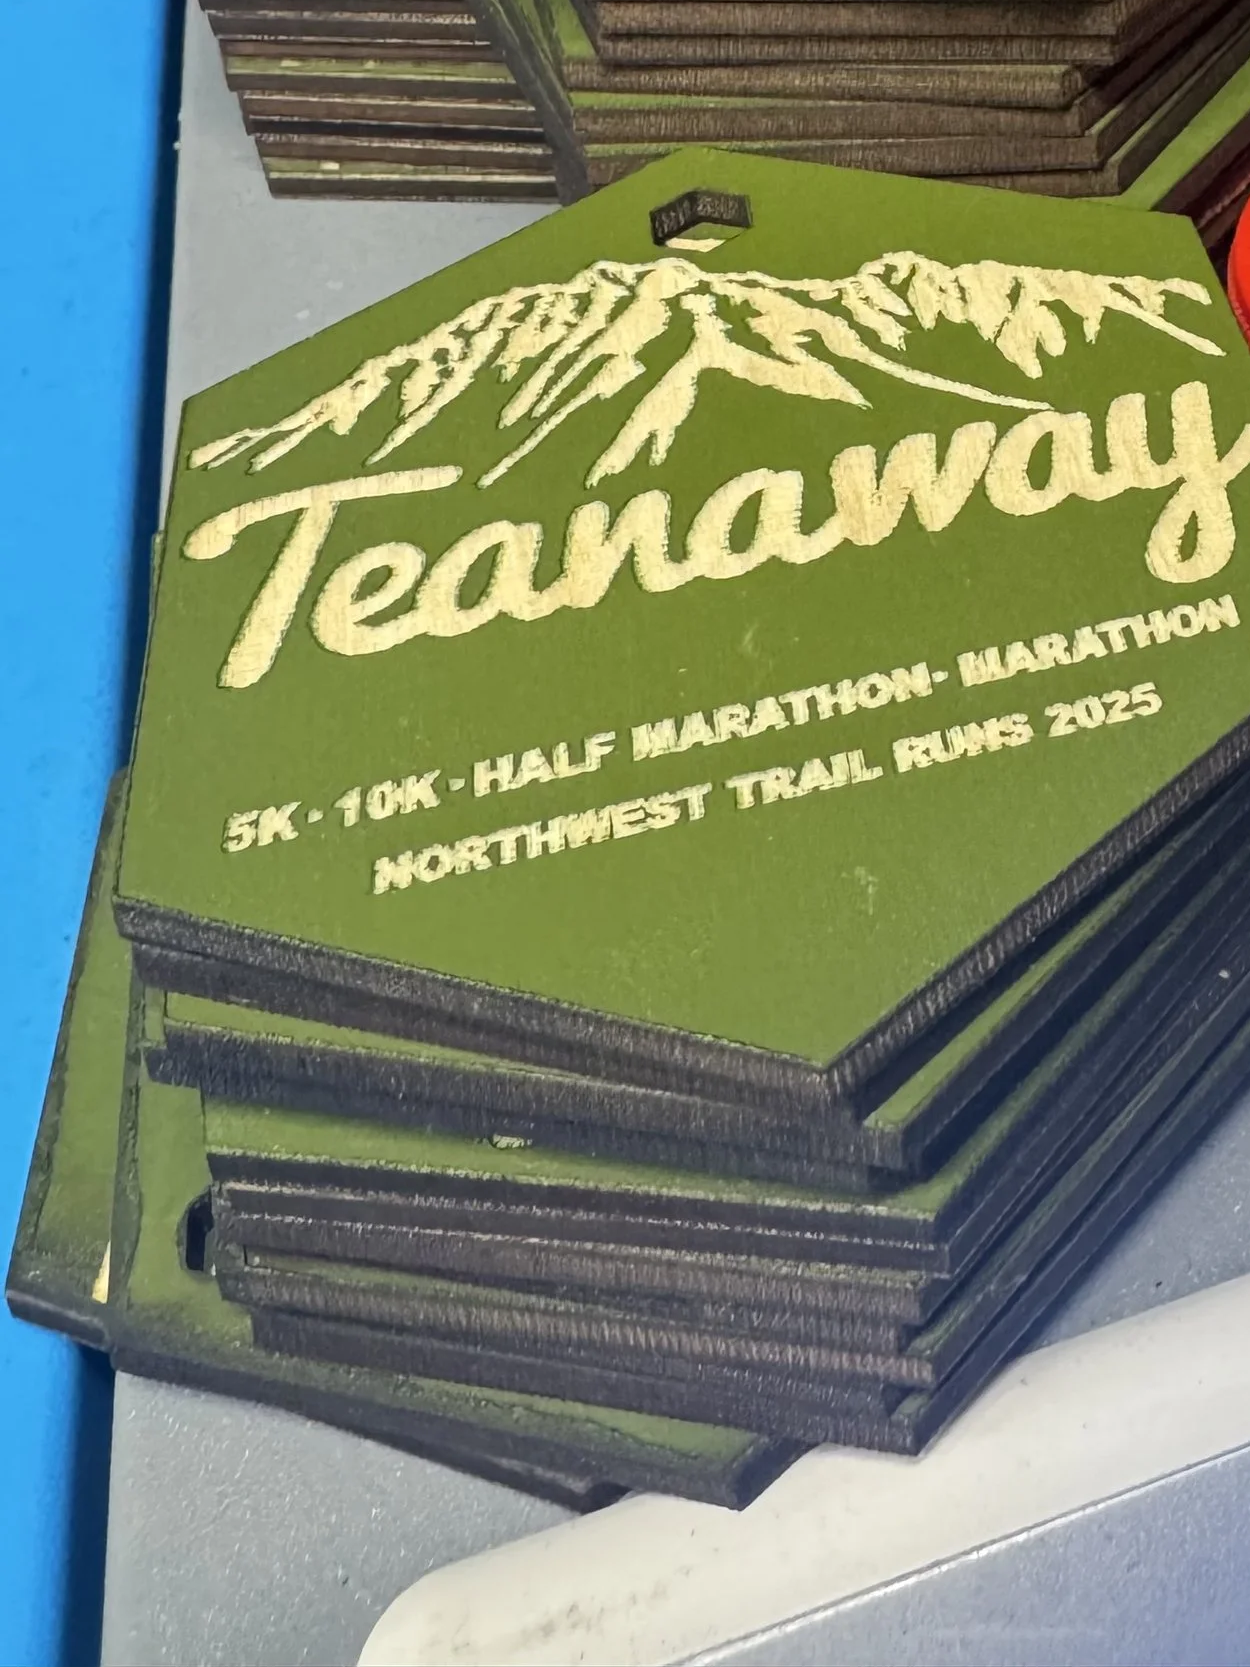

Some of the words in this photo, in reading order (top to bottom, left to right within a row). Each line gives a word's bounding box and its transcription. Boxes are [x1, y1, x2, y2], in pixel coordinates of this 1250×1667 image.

[221, 801, 302, 854] 5K
[332, 769, 441, 827] 10K
[473, 731, 616, 798] HALF
[632, 661, 933, 761] MARATHON
[957, 593, 1241, 688] MARATHON
[372, 782, 712, 895] NORTHWEST
[726, 749, 883, 811] TRAIL
[892, 711, 1034, 773] RUNS
[1046, 680, 1164, 738] 2025
